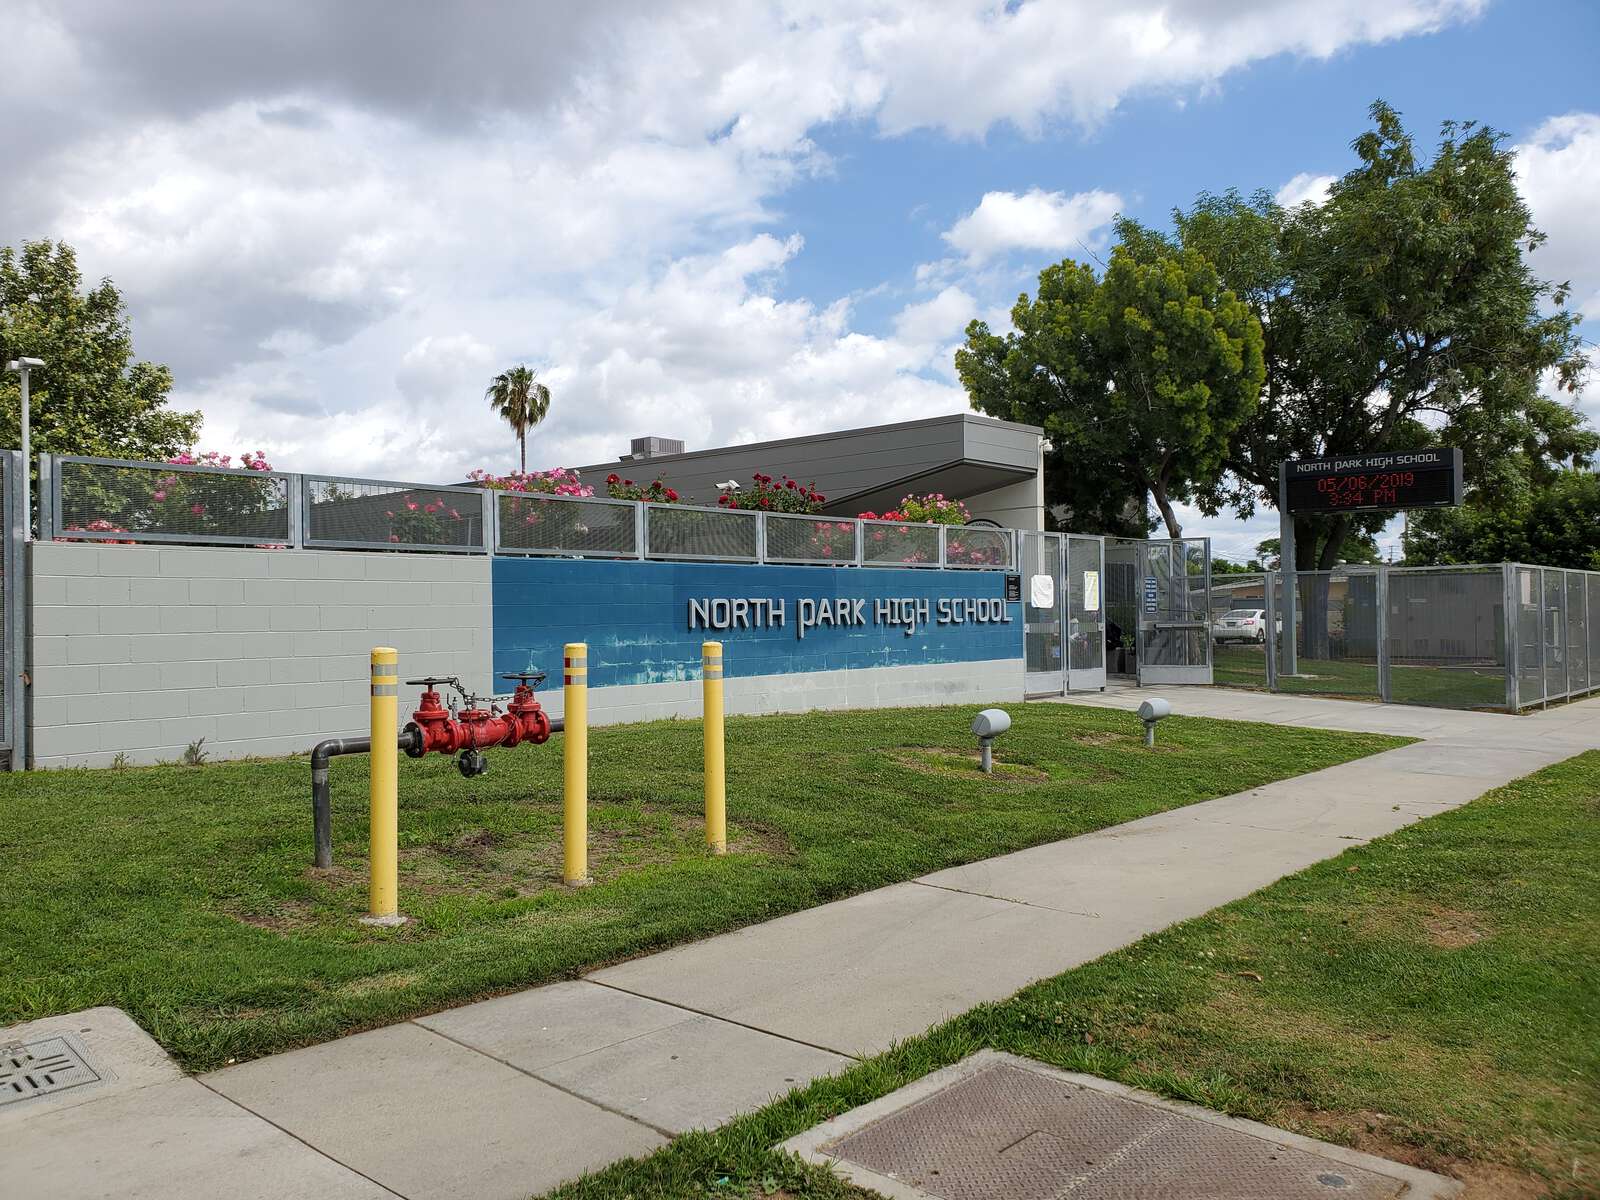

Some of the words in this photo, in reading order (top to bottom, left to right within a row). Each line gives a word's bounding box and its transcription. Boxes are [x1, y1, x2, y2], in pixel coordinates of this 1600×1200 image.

[1296, 462, 1331, 472] NORTH
[1396, 454, 1440, 464] SCHOOL
[1318, 473, 1414, 492] 05/06/2019
[1374, 489, 1396, 504] PM
[688, 598, 786, 629] NORTH
[874, 598, 930, 636] HIGH
[936, 598, 1014, 623] SCHOOL
